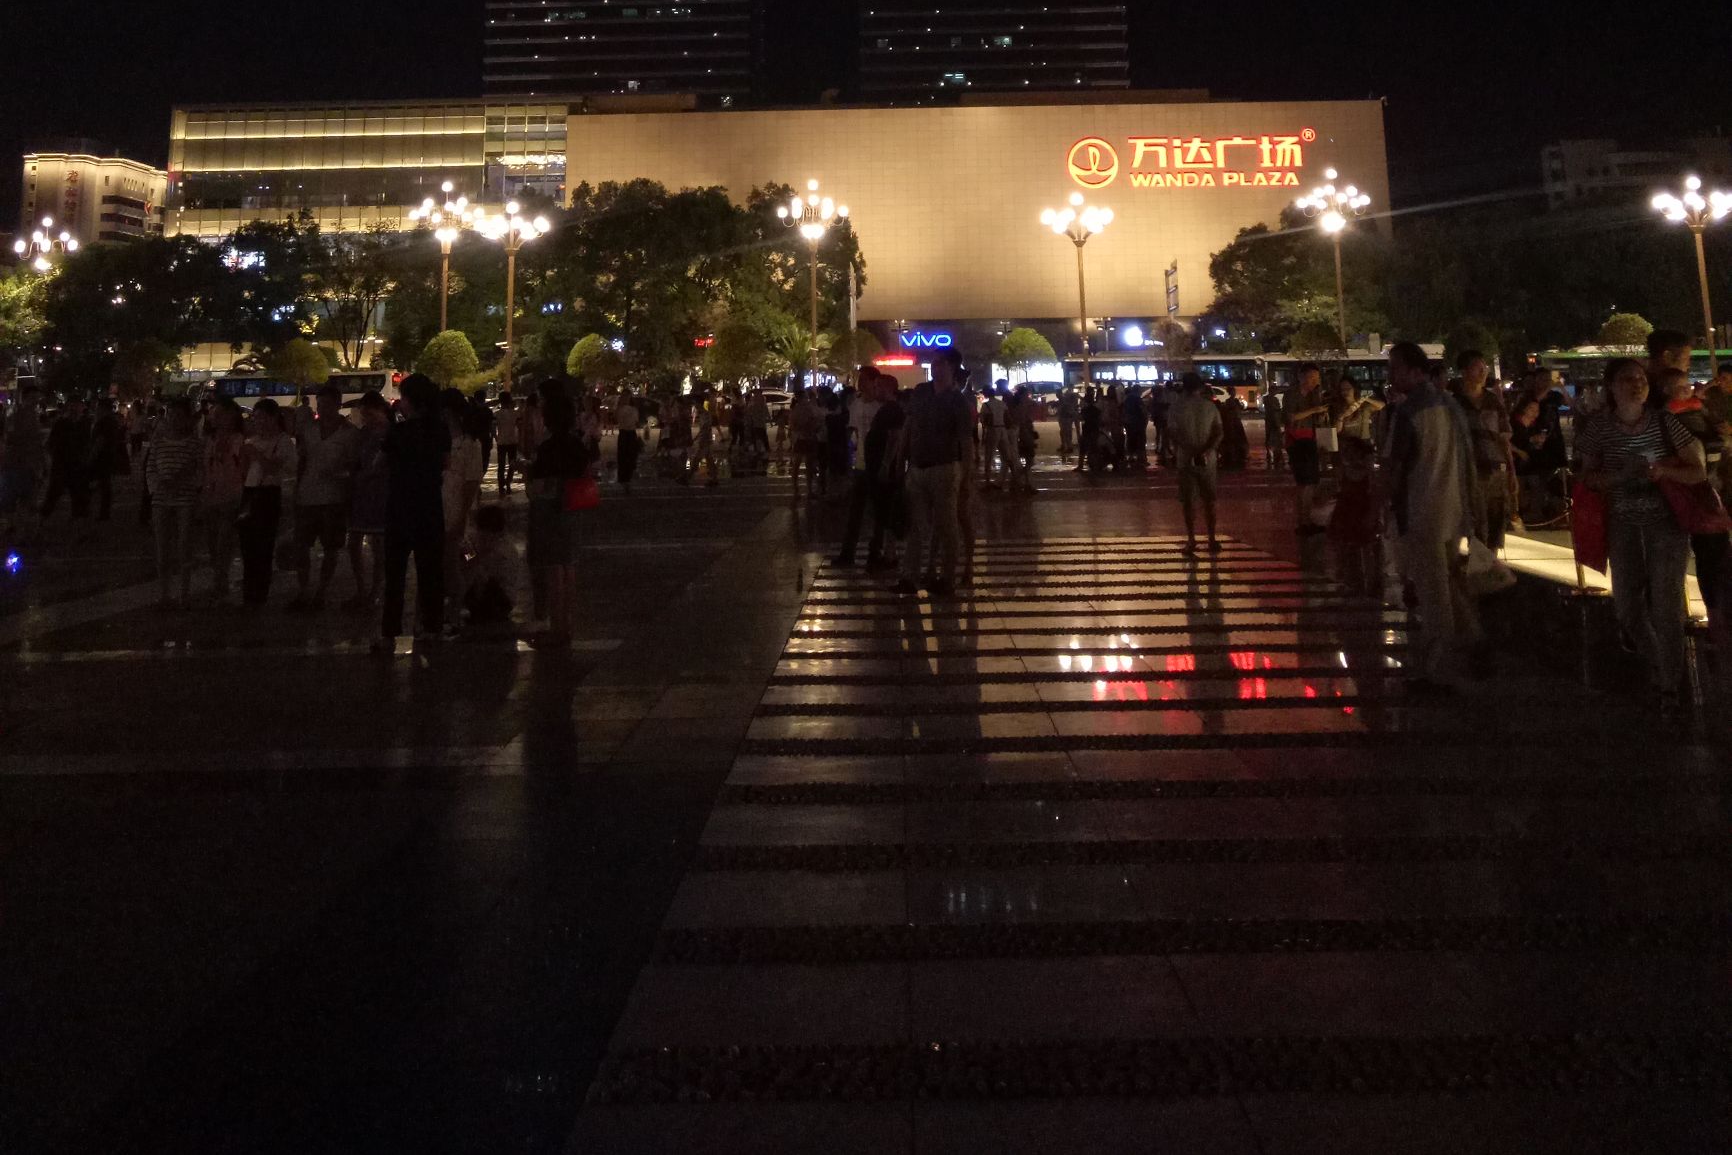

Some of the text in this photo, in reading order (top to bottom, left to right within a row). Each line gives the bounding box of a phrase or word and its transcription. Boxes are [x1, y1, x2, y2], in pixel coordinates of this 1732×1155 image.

[1128, 136, 1303, 168] 万达广场
[1130, 171, 1299, 187] WANDA PLAZA
[901, 331, 952, 347] vivo
